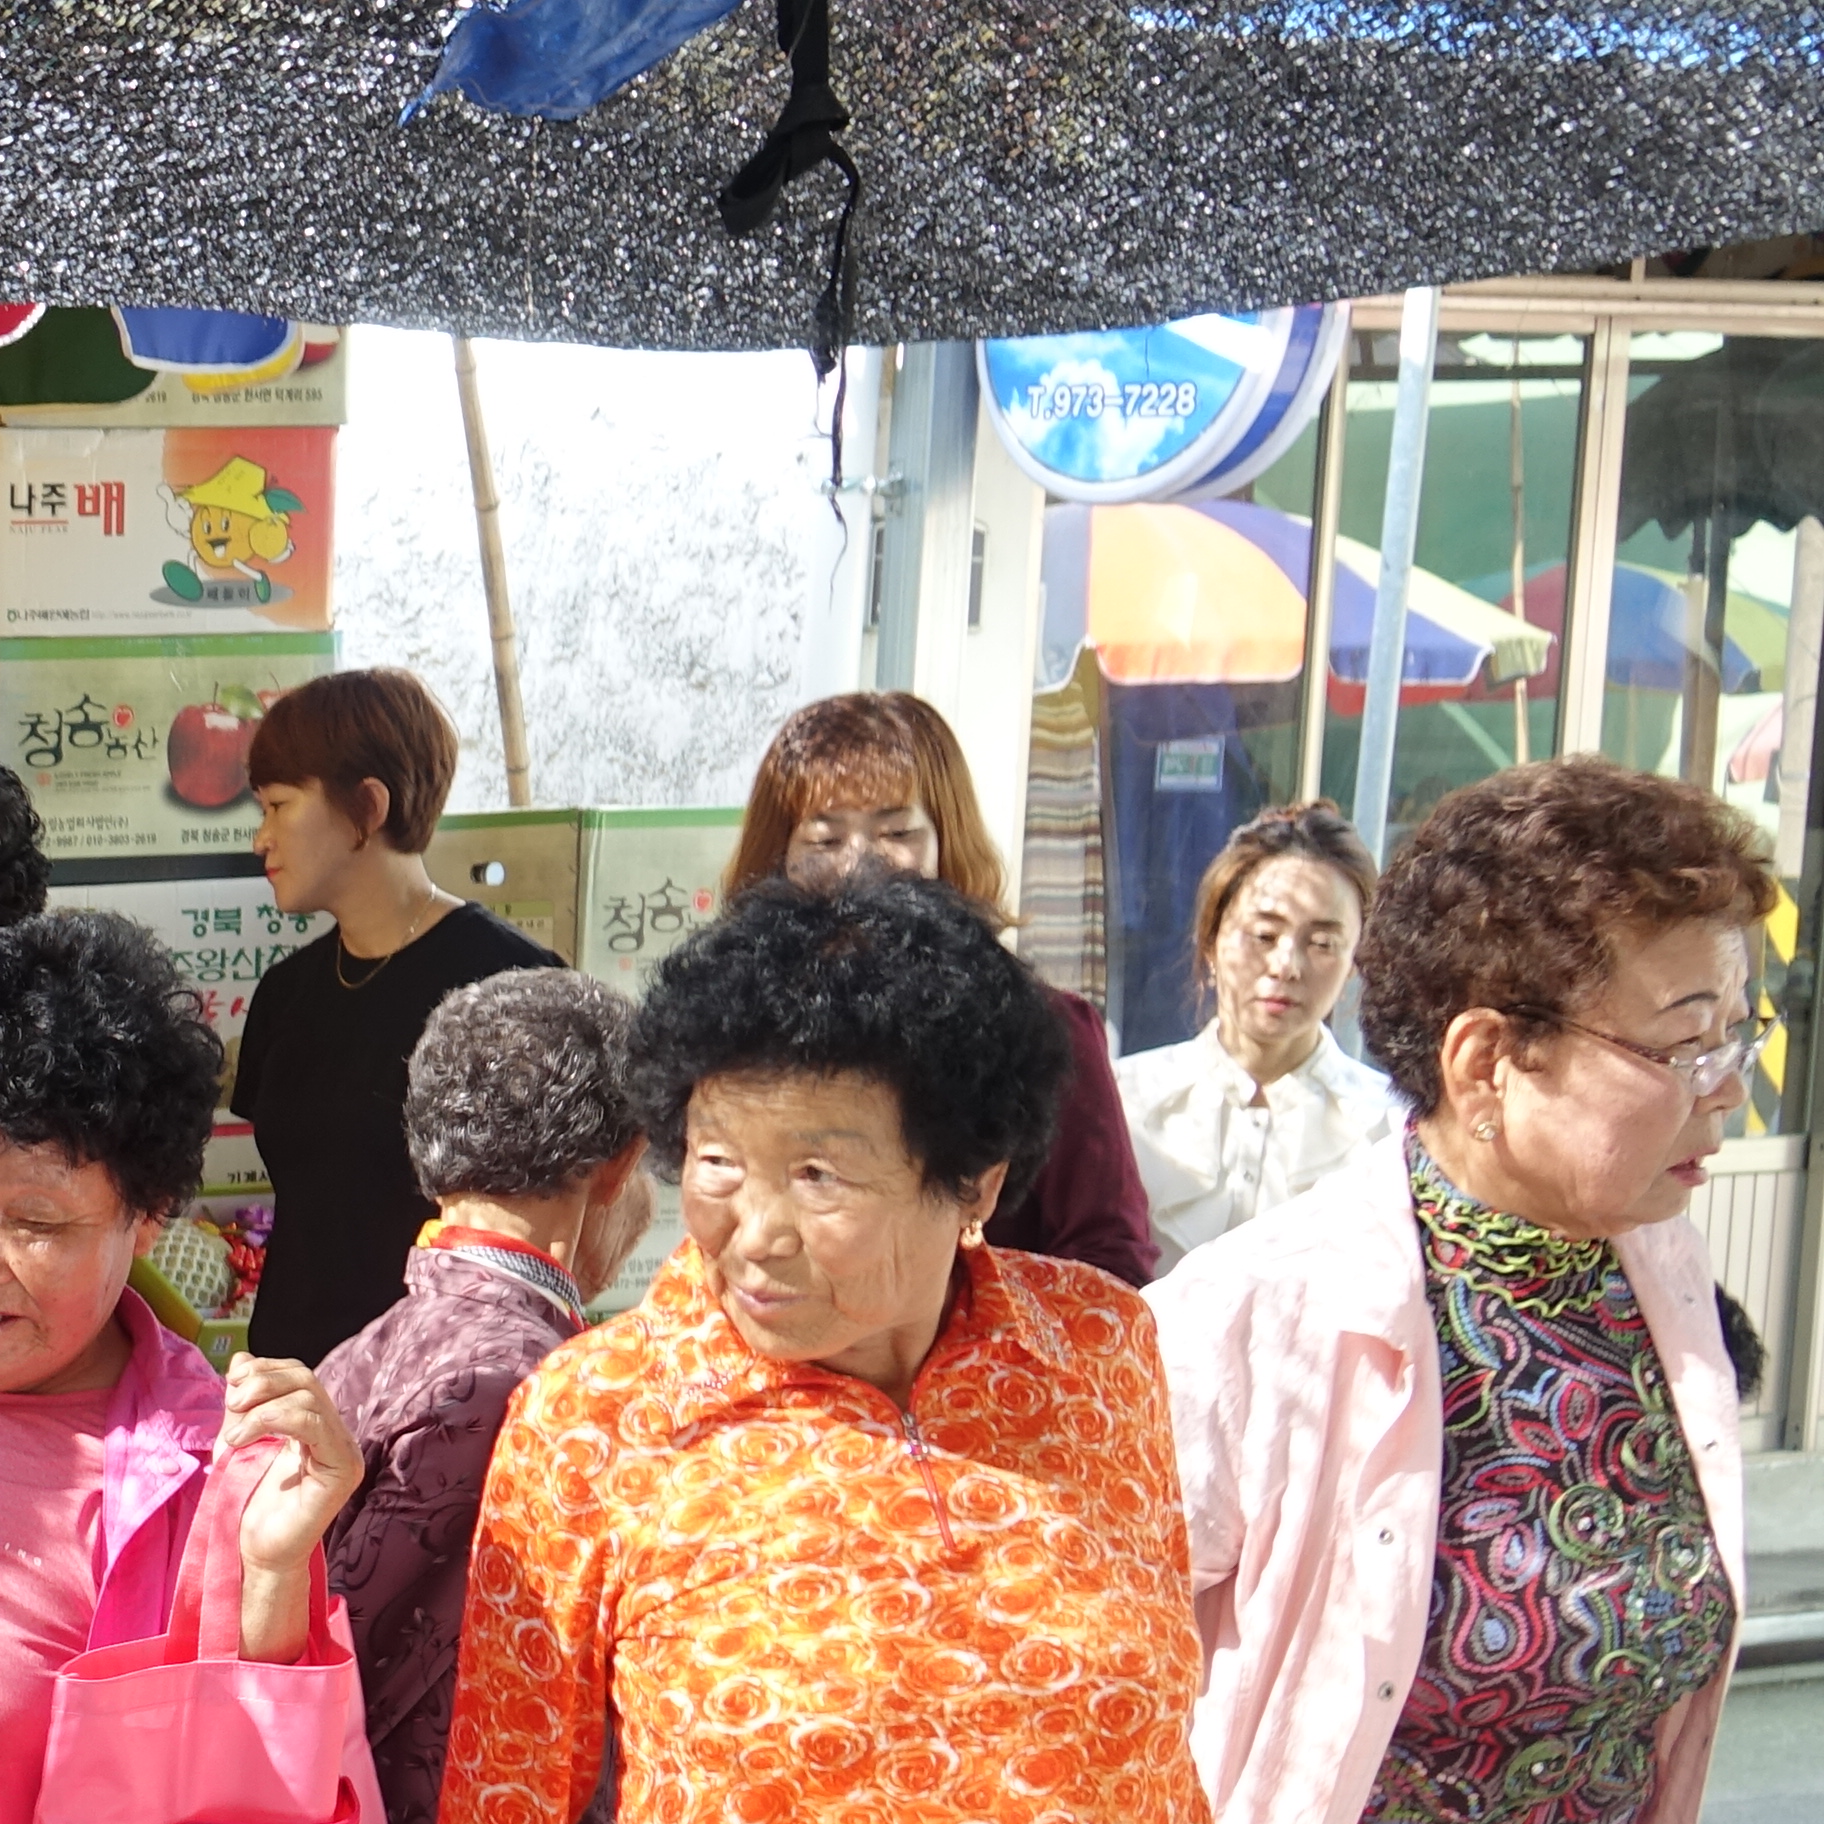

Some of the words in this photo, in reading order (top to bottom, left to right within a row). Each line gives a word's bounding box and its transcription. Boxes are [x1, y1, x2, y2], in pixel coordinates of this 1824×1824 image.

[10, 483, 68, 517] 나주
[74, 481, 125, 537] 배
[181, 907, 242, 938] 경북
